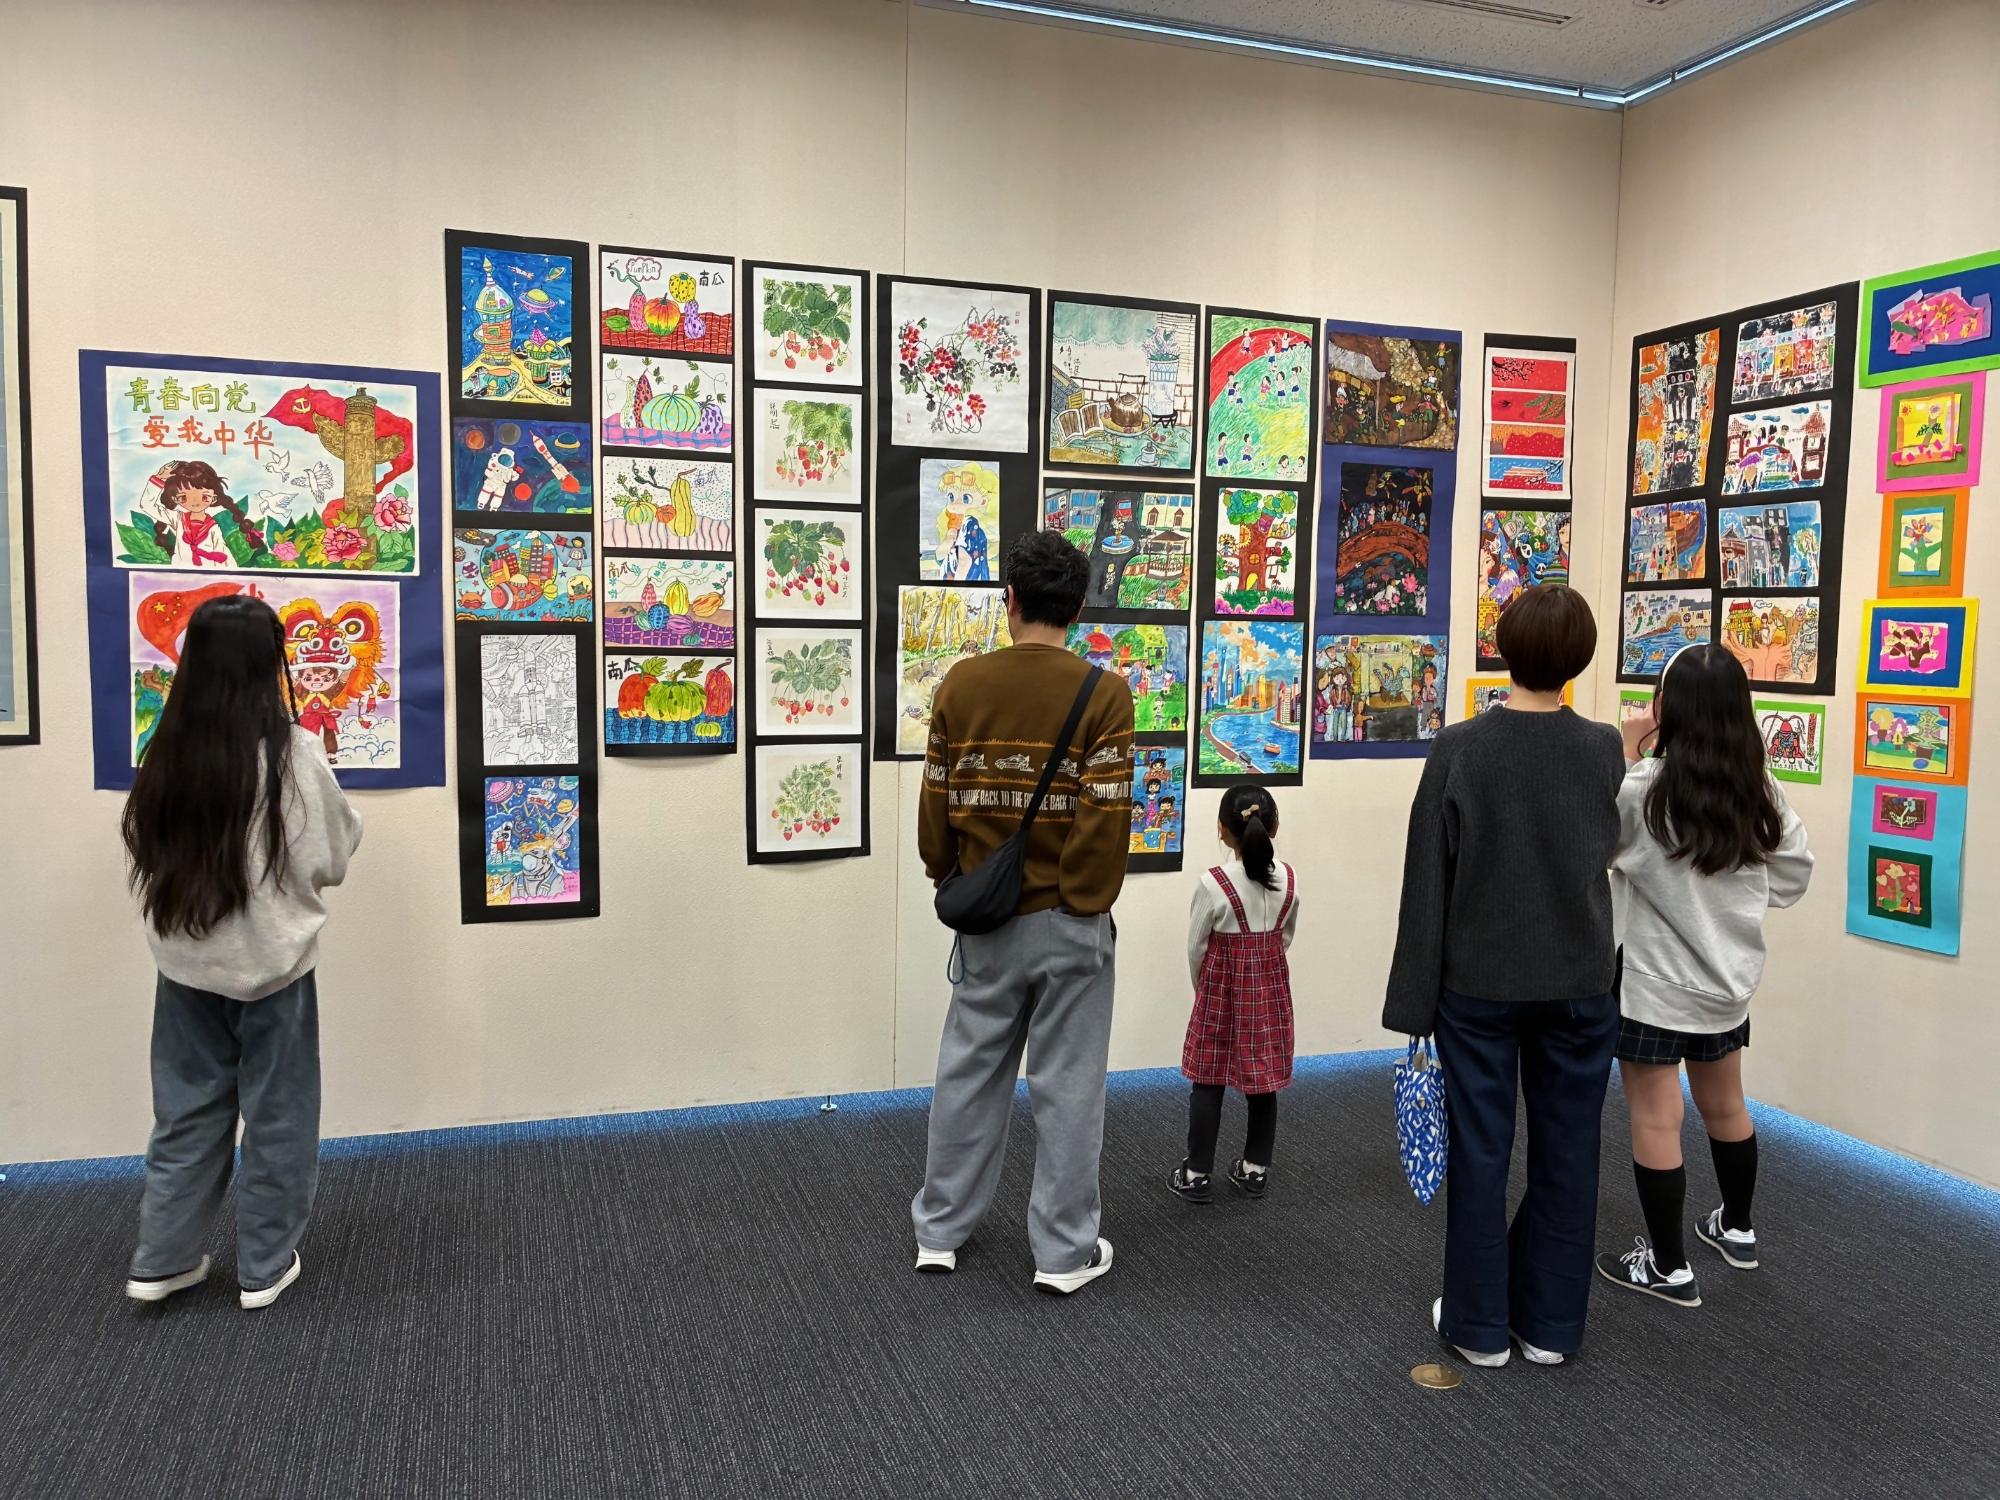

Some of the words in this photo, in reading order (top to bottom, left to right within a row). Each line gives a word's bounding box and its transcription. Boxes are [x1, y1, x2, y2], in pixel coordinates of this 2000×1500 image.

[699, 269, 725, 287] 南瓜
[124, 376, 256, 413] 青春向党
[142, 415, 275, 460] 爱我中华
[607, 656, 640, 680] 南瓜
[980, 789, 1000, 806] BACK
[1001, 790, 1010, 807] TO
[1011, 791, 1023, 808] THE
[1050, 794, 1068, 811] BACK
